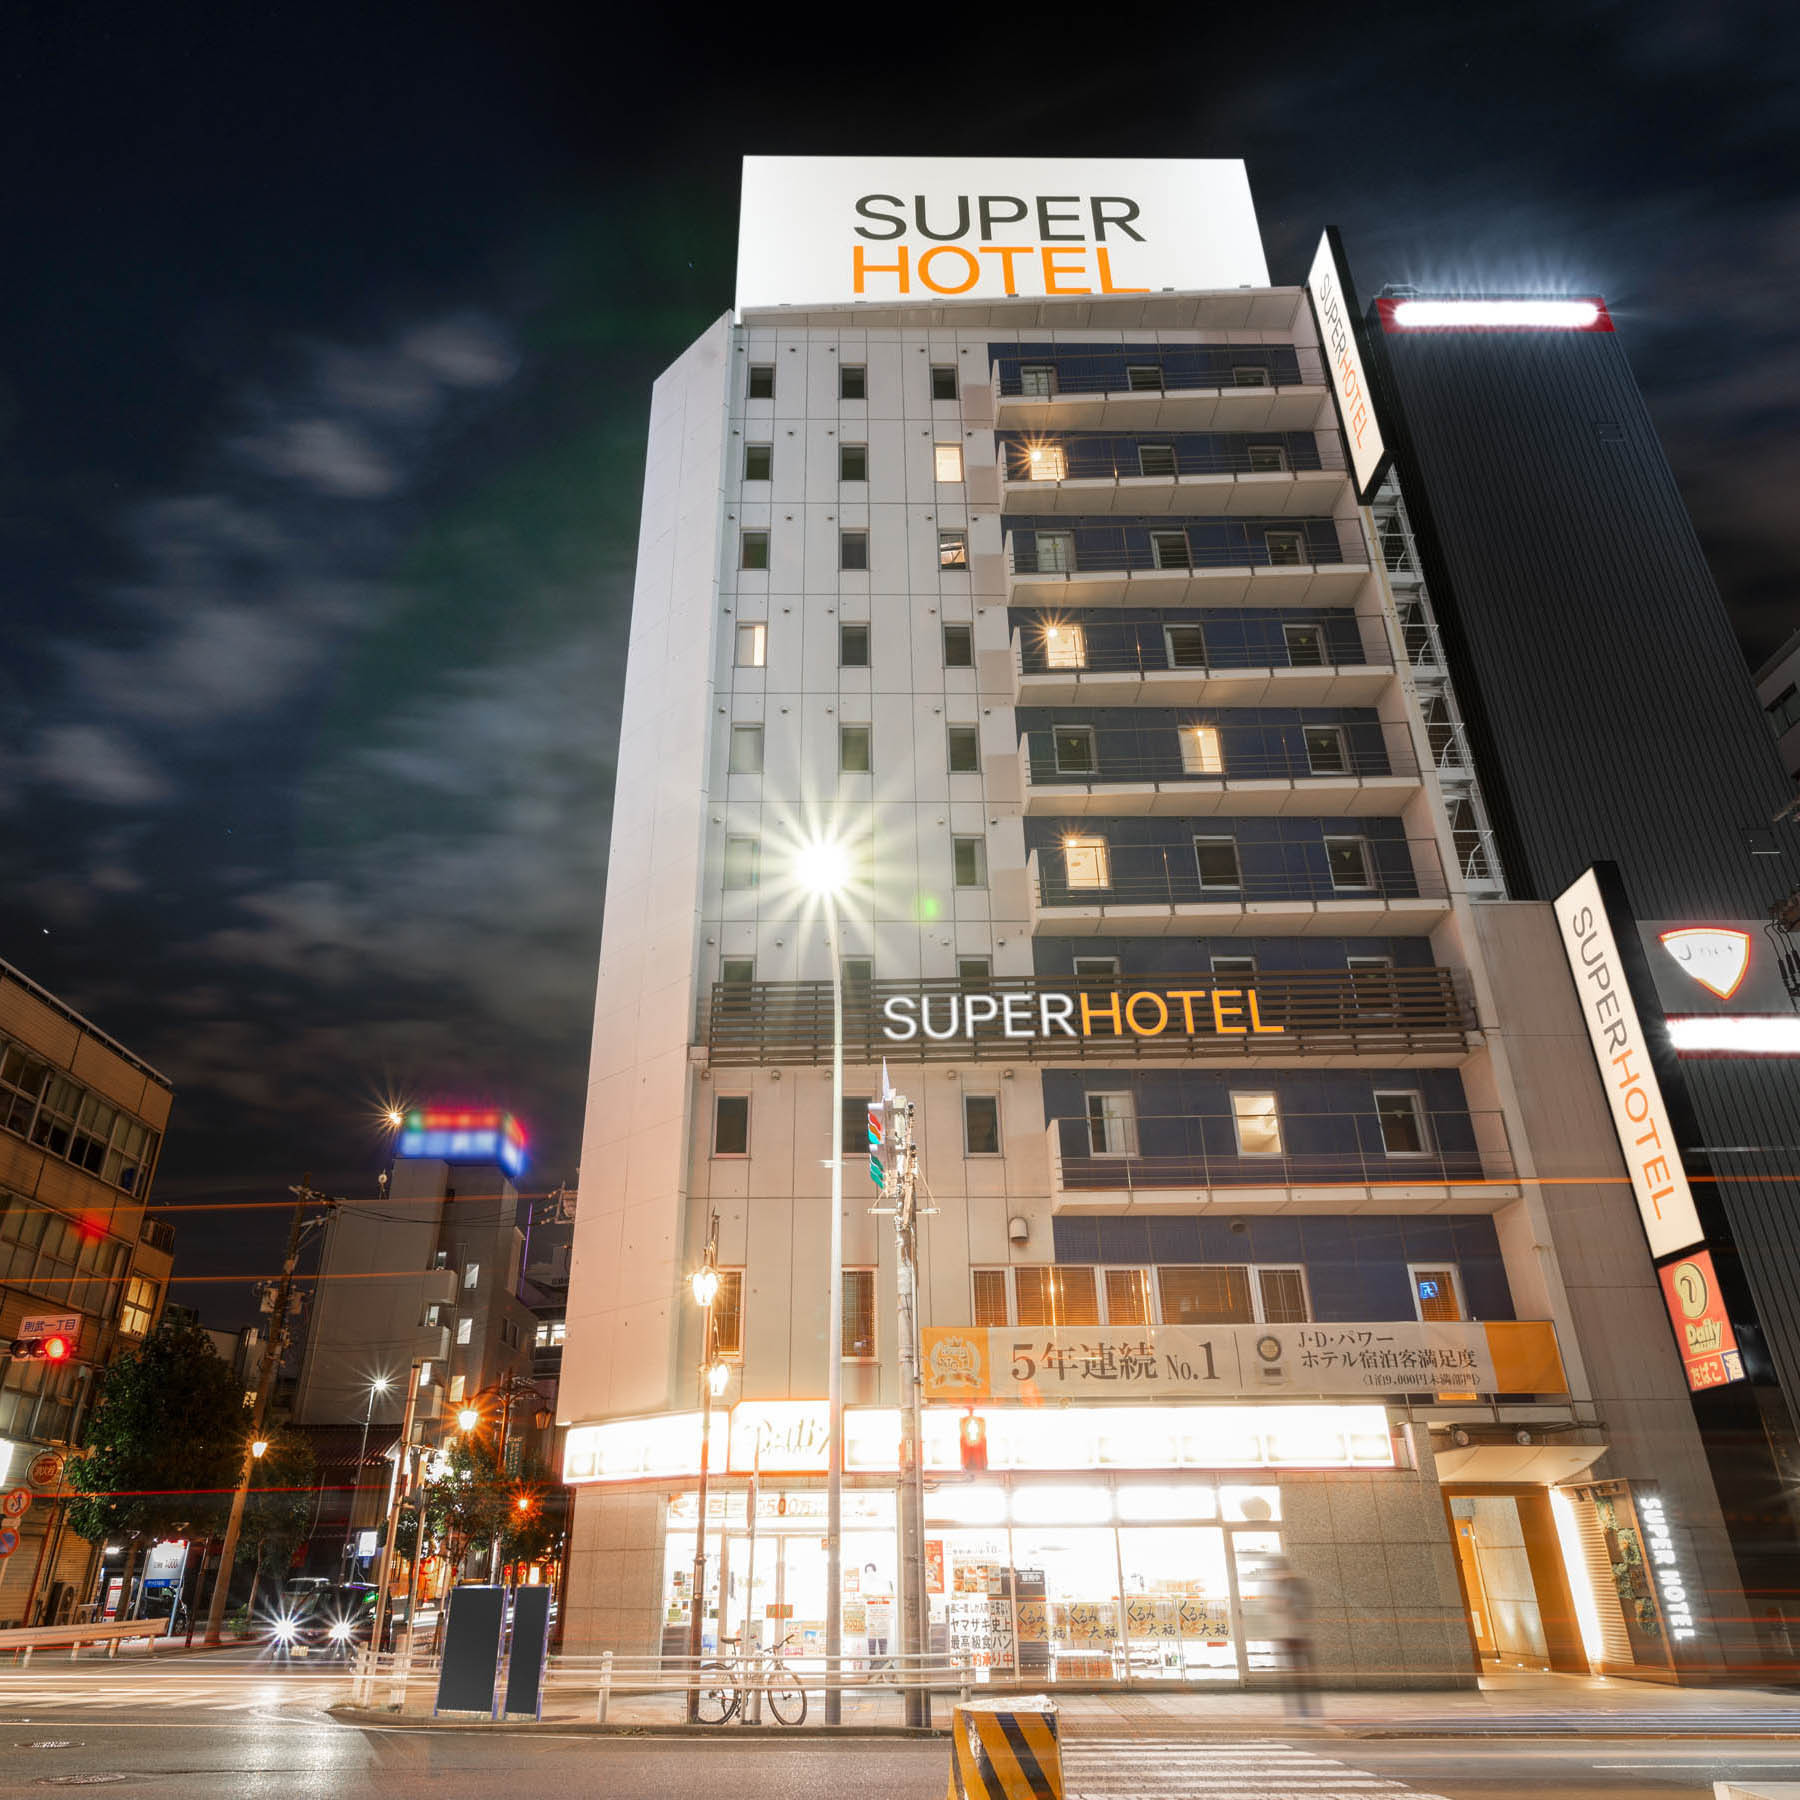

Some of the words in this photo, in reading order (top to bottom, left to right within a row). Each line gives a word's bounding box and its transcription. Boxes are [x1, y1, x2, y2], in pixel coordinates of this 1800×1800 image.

[853, 194, 1147, 242] SUPER
[853, 245, 1151, 295] HOTEL
[24, 1319, 76, 1332] 則武一丁目
[1685, 1318, 1722, 1348] Daily
[1011, 1341, 1159, 1381] 5年連続
[1165, 1341, 1221, 1381] No.1
[1301, 1350, 1478, 1369] ホテル宿泊客満足度
[1723, 1352, 1745, 1381] 酒
[1690, 1361, 1722, 1387] たばこ
[1640, 1498, 1676, 1565] SUPER
[1658, 1570, 1695, 1640] HOTEL
[1071, 1603, 1097, 1624] くるみ
[1127, 1600, 1155, 1622] くるみ
[1180, 1601, 1207, 1622] くるみ
[1088, 1626, 1118, 1639] 大福
[1147, 1623, 1176, 1636] 大福
[1200, 1623, 1229, 1637] 大福
